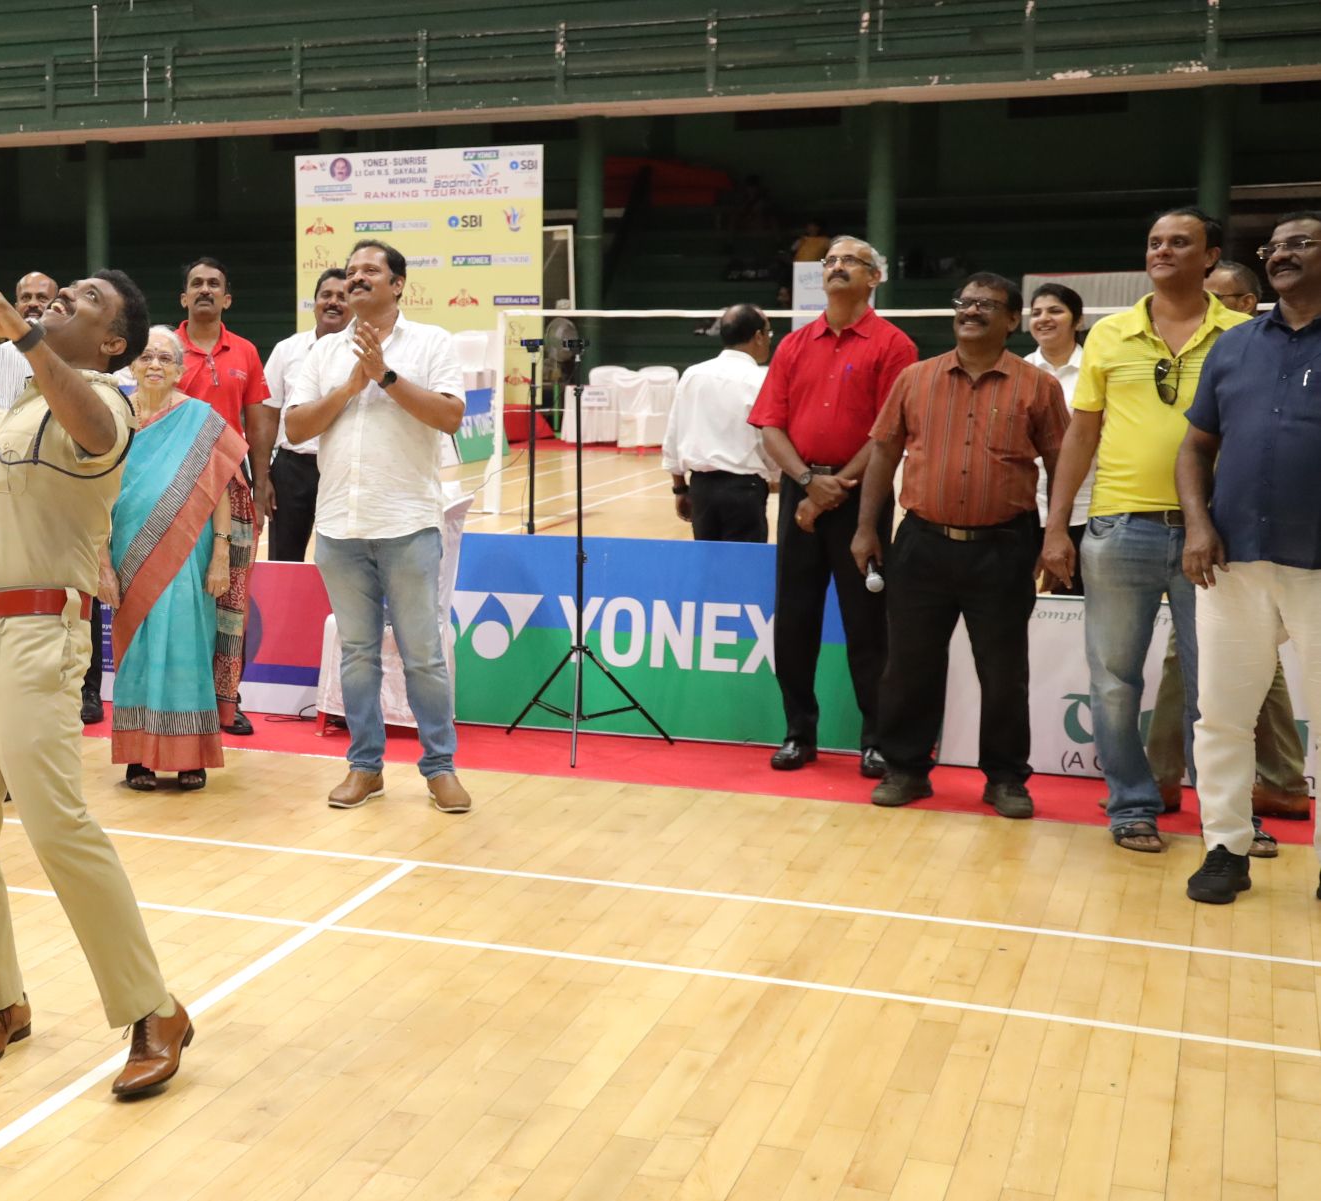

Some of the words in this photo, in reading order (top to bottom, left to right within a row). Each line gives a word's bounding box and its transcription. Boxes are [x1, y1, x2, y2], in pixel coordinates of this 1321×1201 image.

[362, 159, 388, 167] YONEX
[393, 156, 427, 166] SUNRISE
[520, 160, 538, 170] SBI
[388, 177, 427, 185] MEMORIAL
[364, 190, 419, 199] RANKING
[424, 186, 509, 197] TOURNAMENT
[369, 222, 391, 230] YONEX
[461, 215, 482, 228] SBI
[468, 256, 490, 265] YONEX
[558, 594, 776, 675] YONEX
